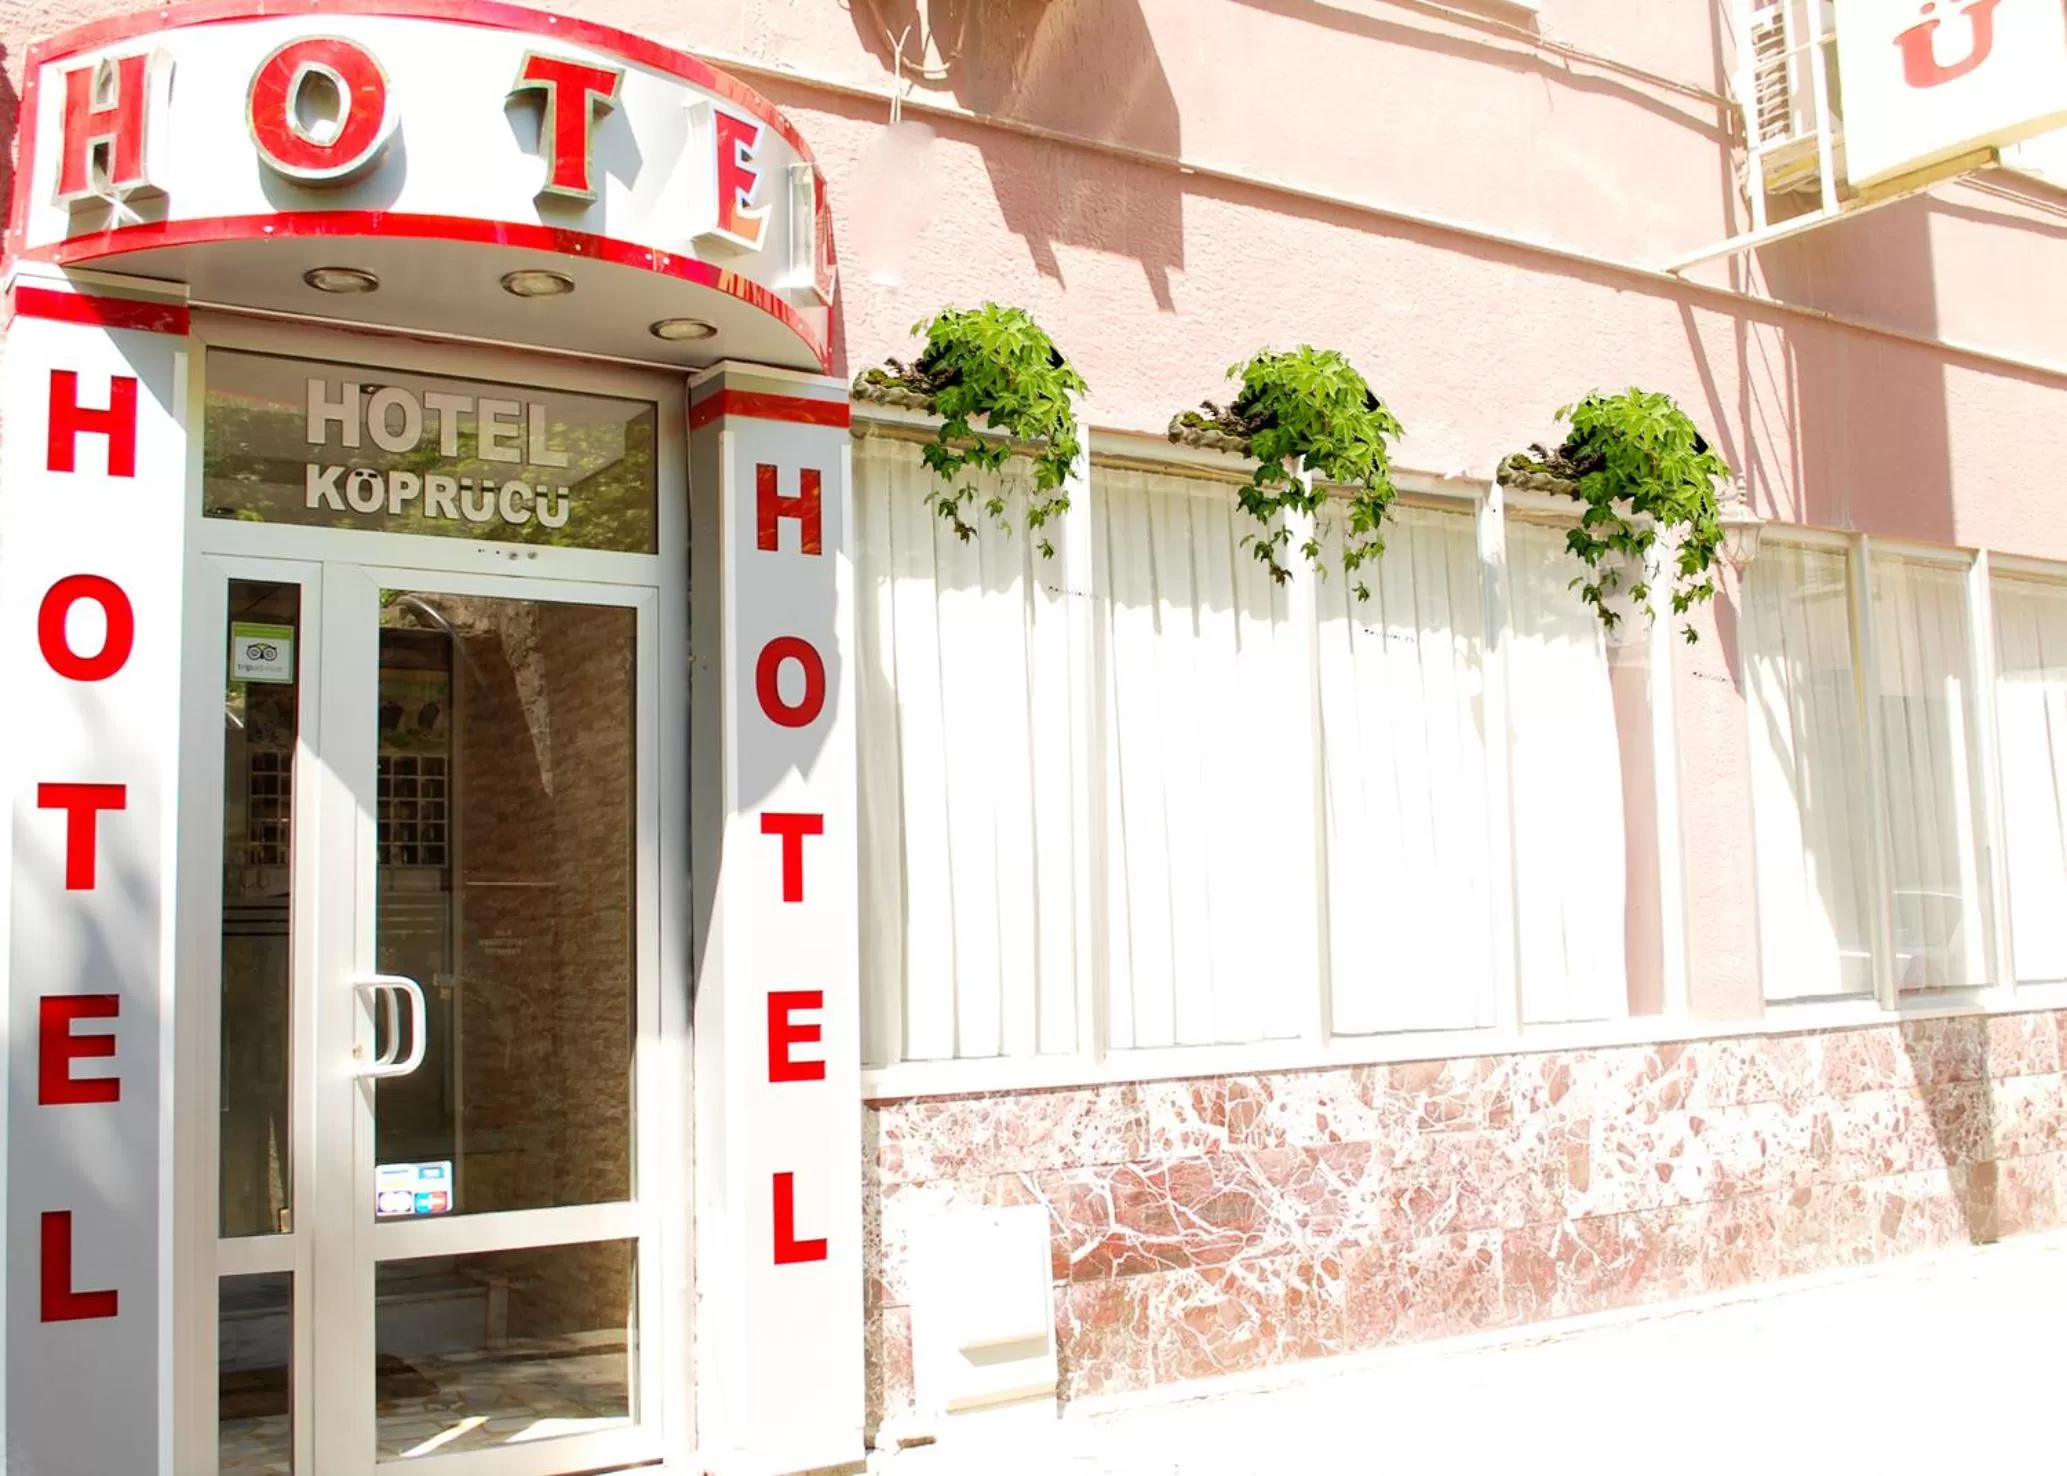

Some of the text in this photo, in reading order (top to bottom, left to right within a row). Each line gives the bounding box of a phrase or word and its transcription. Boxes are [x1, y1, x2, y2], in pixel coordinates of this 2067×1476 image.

[304, 463, 571, 529] KÖPRÜCÜ
[307, 378, 569, 467] HOTEL
[37, 368, 138, 1322] HOTEL
[755, 464, 829, 1266] HOTEL
